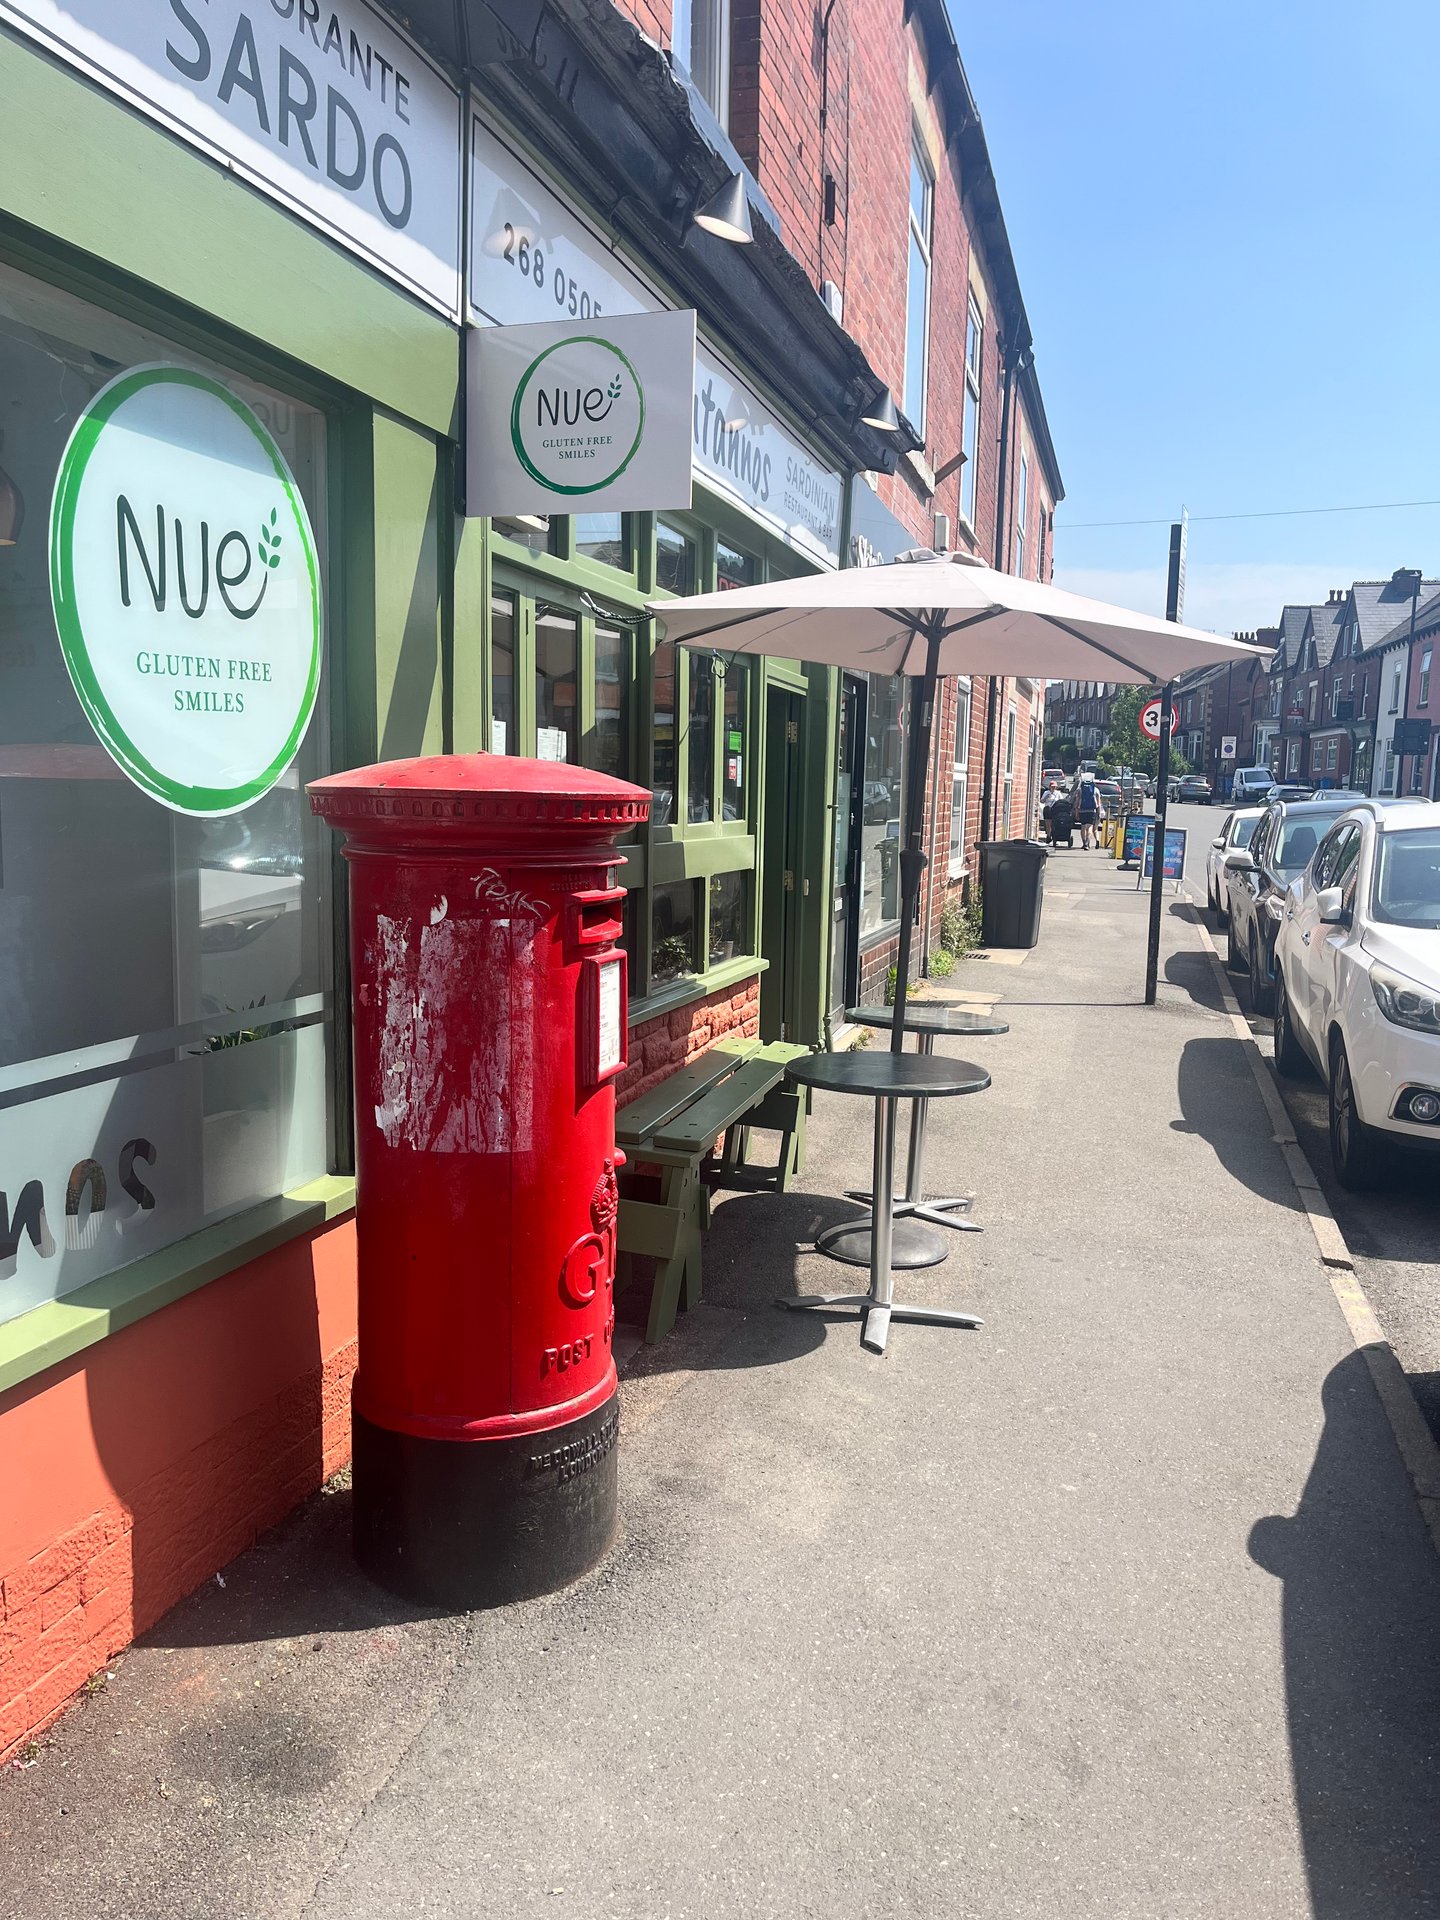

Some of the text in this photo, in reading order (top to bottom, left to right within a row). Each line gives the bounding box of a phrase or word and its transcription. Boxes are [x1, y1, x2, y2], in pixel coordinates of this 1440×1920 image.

[166, 0, 412, 229] SARDO
[504, 222, 544, 288] 268
[542, 435, 613, 449] GLUTEN FREE
[558, 448, 596, 460] SMILES
[786, 456, 835, 521] SARDINIAN
[784, 491, 818, 530] RESTAURANT
[823, 524, 833, 542] BAR
[136, 651, 272, 682] GLUTEN FREE
[174, 689, 245, 713] SMILES
[543, 1334, 594, 1376] POST
